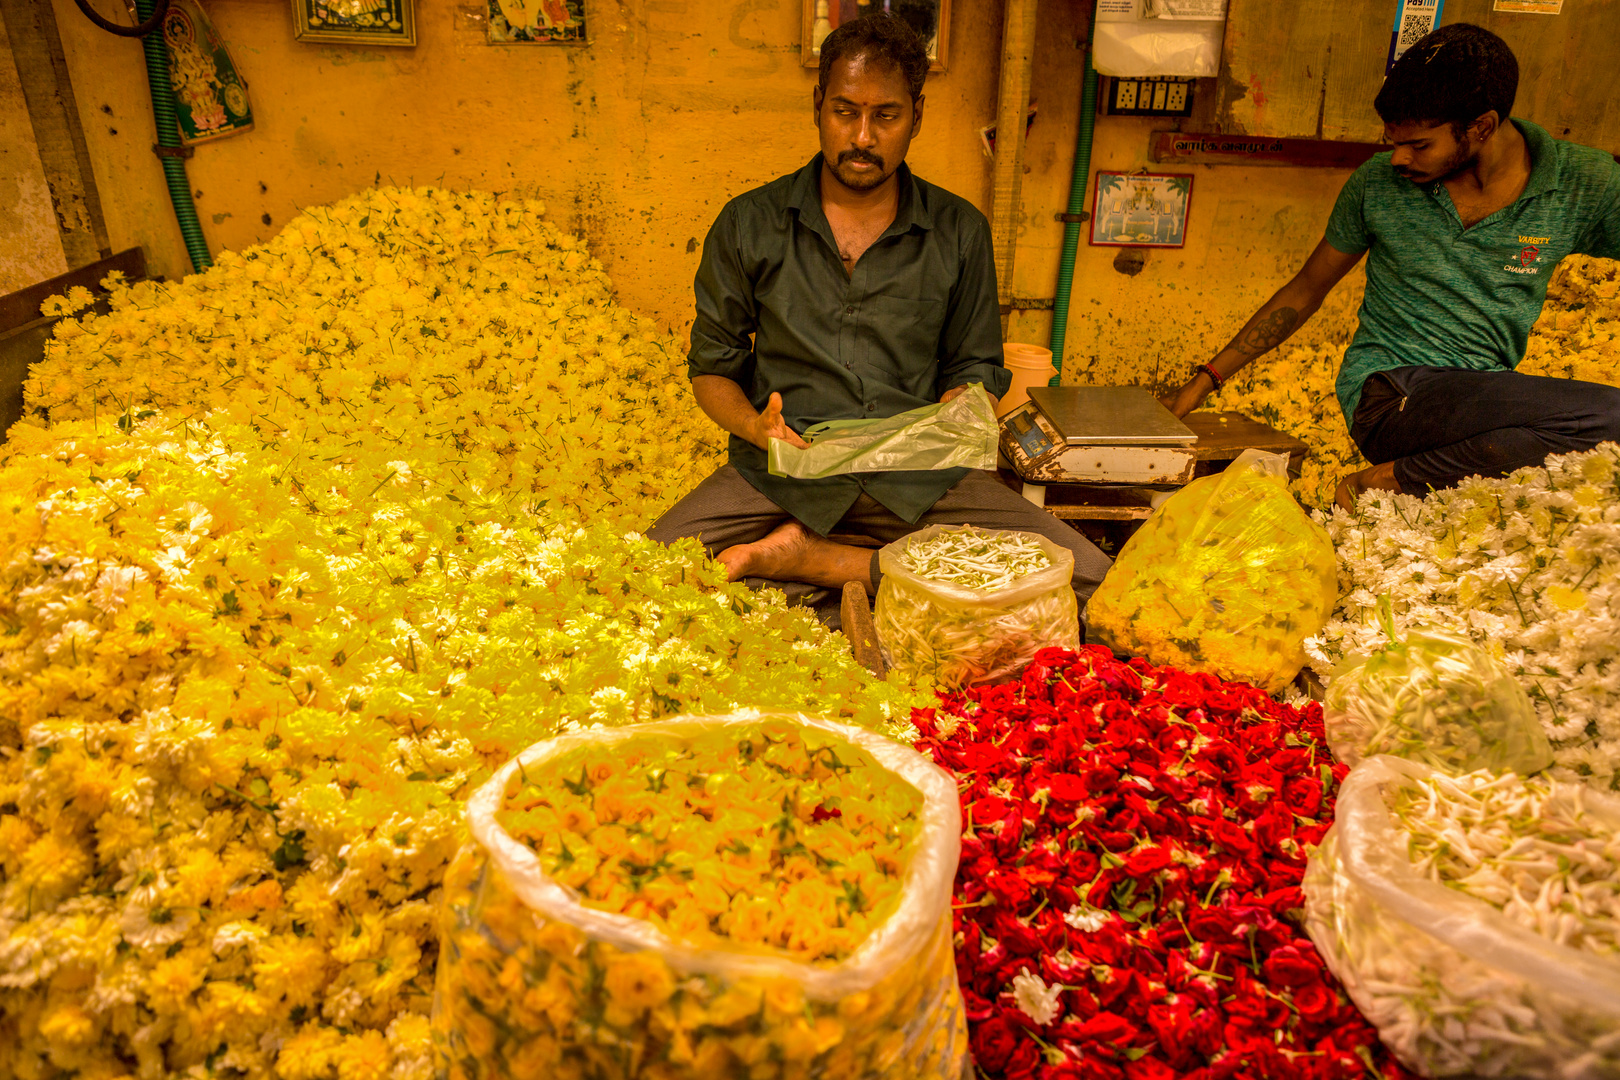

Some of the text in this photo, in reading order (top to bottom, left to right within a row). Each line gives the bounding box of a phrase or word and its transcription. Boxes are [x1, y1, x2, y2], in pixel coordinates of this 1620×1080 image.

[1174, 139, 1283, 153] வாழ்க வளமுடன்
[1518, 235, 1551, 244] VARSITY
[1503, 264, 1538, 274] CHAMPION
